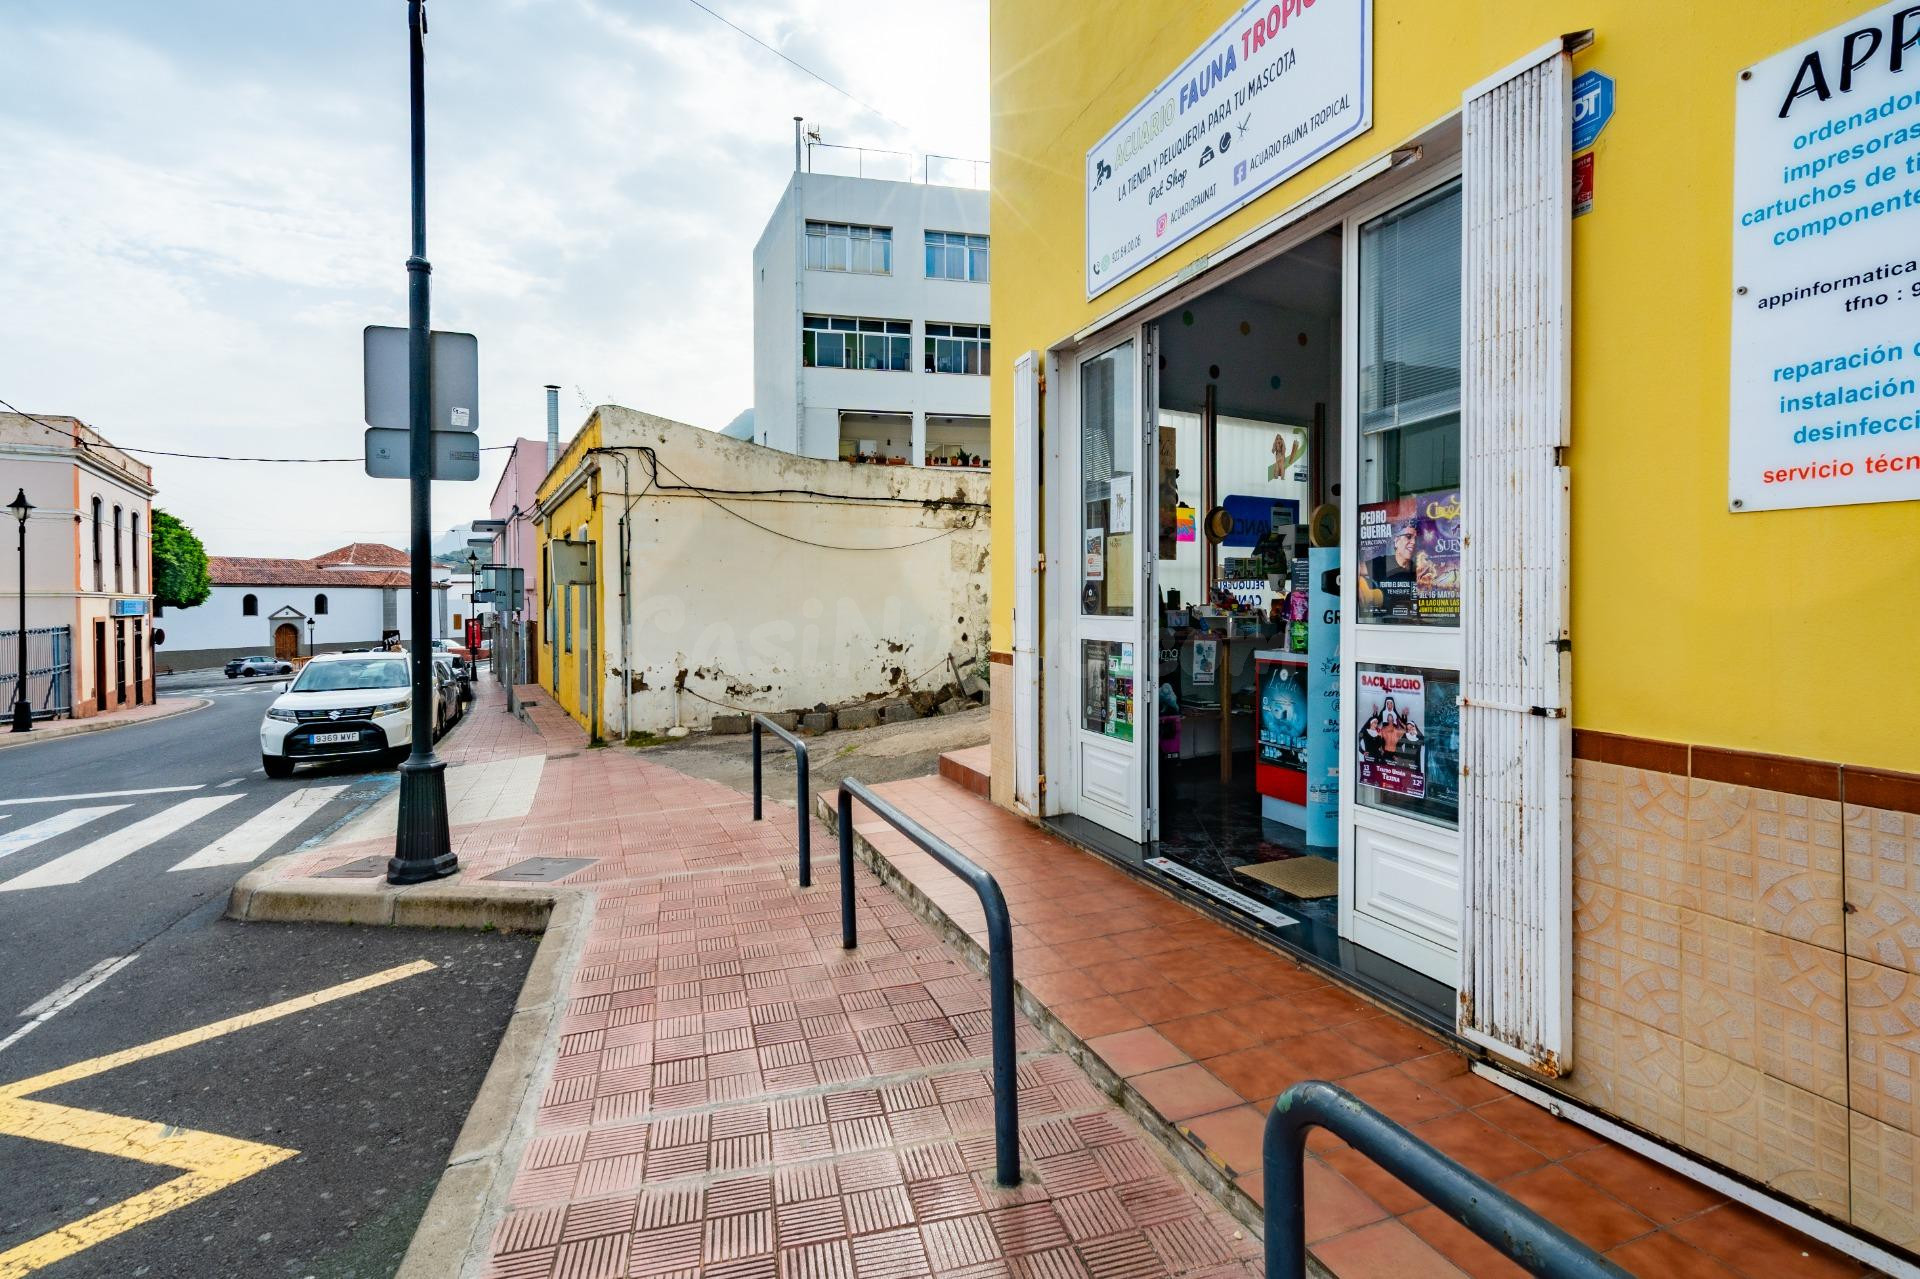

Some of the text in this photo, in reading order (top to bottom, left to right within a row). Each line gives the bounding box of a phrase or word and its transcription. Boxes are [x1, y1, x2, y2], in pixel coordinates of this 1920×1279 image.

[1113, 0, 1316, 171] ACUARIO FAUNA TROP
[1572, 88, 1600, 123] DT
[1118, 184, 1127, 202] LA
[1127, 163, 1152, 196] TIENDA
[1159, 119, 1206, 170] PELUQUERIA
[1208, 98, 1232, 132] PARA
[1234, 86, 1246, 111] TU
[1248, 47, 1297, 101] MASCOTA
[1250, 93, 1351, 174] ACUARIO FAUNA TROPICAL
[1783, 122, 1920, 184] impresoras
[1148, 168, 1188, 206] Pet Shop
[1741, 178, 1857, 227] cartuchos
[1865, 165, 1896, 187] de
[1758, 260, 1917, 309] appinformatica
[1845, 293, 1888, 312] tfno
[1773, 344, 1903, 382] reparación
[1780, 378, 1915, 413] instalación
[1793, 410, 1920, 444] desinfecci
[1763, 454, 1920, 484] servicio técn
[1360, 510, 1386, 525] PEDRO
[1360, 524, 1392, 540] GUERRA
[315, 734, 338, 743] 9369
